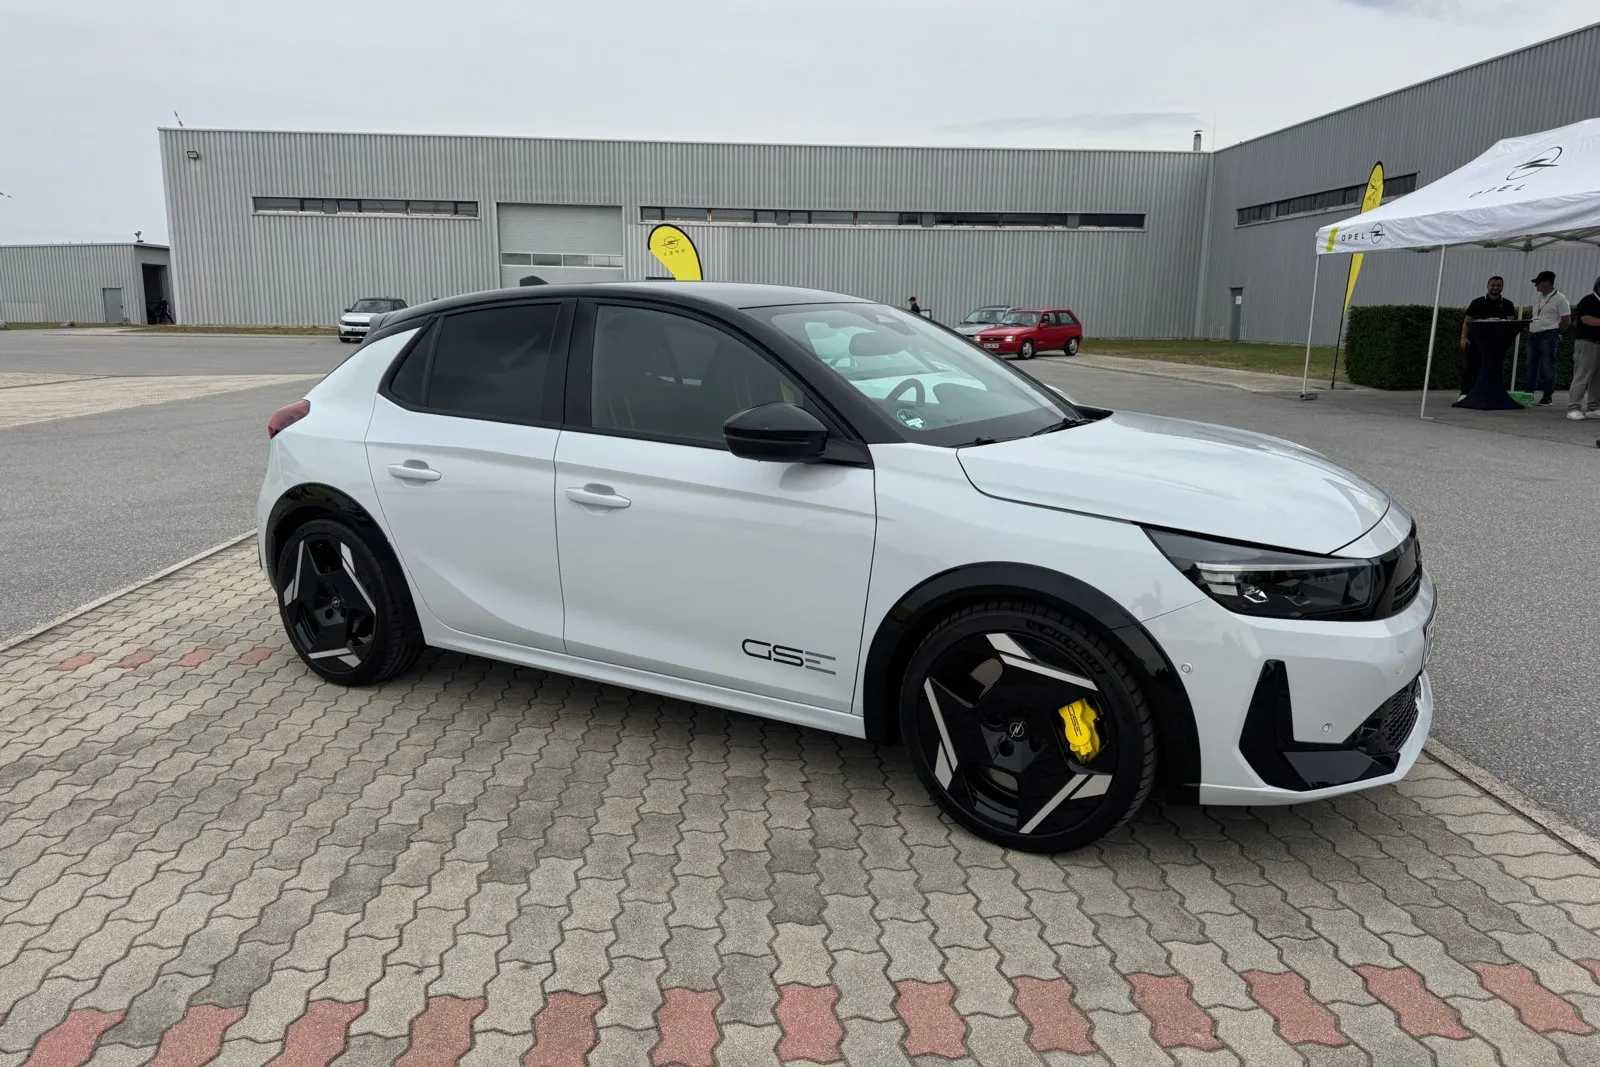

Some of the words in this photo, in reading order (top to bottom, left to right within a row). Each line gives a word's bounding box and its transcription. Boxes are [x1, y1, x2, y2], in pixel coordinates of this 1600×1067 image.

[1341, 233, 1365, 242] OPEL
[741, 638, 837, 676] GSE
[1067, 704, 1083, 737] GSE
